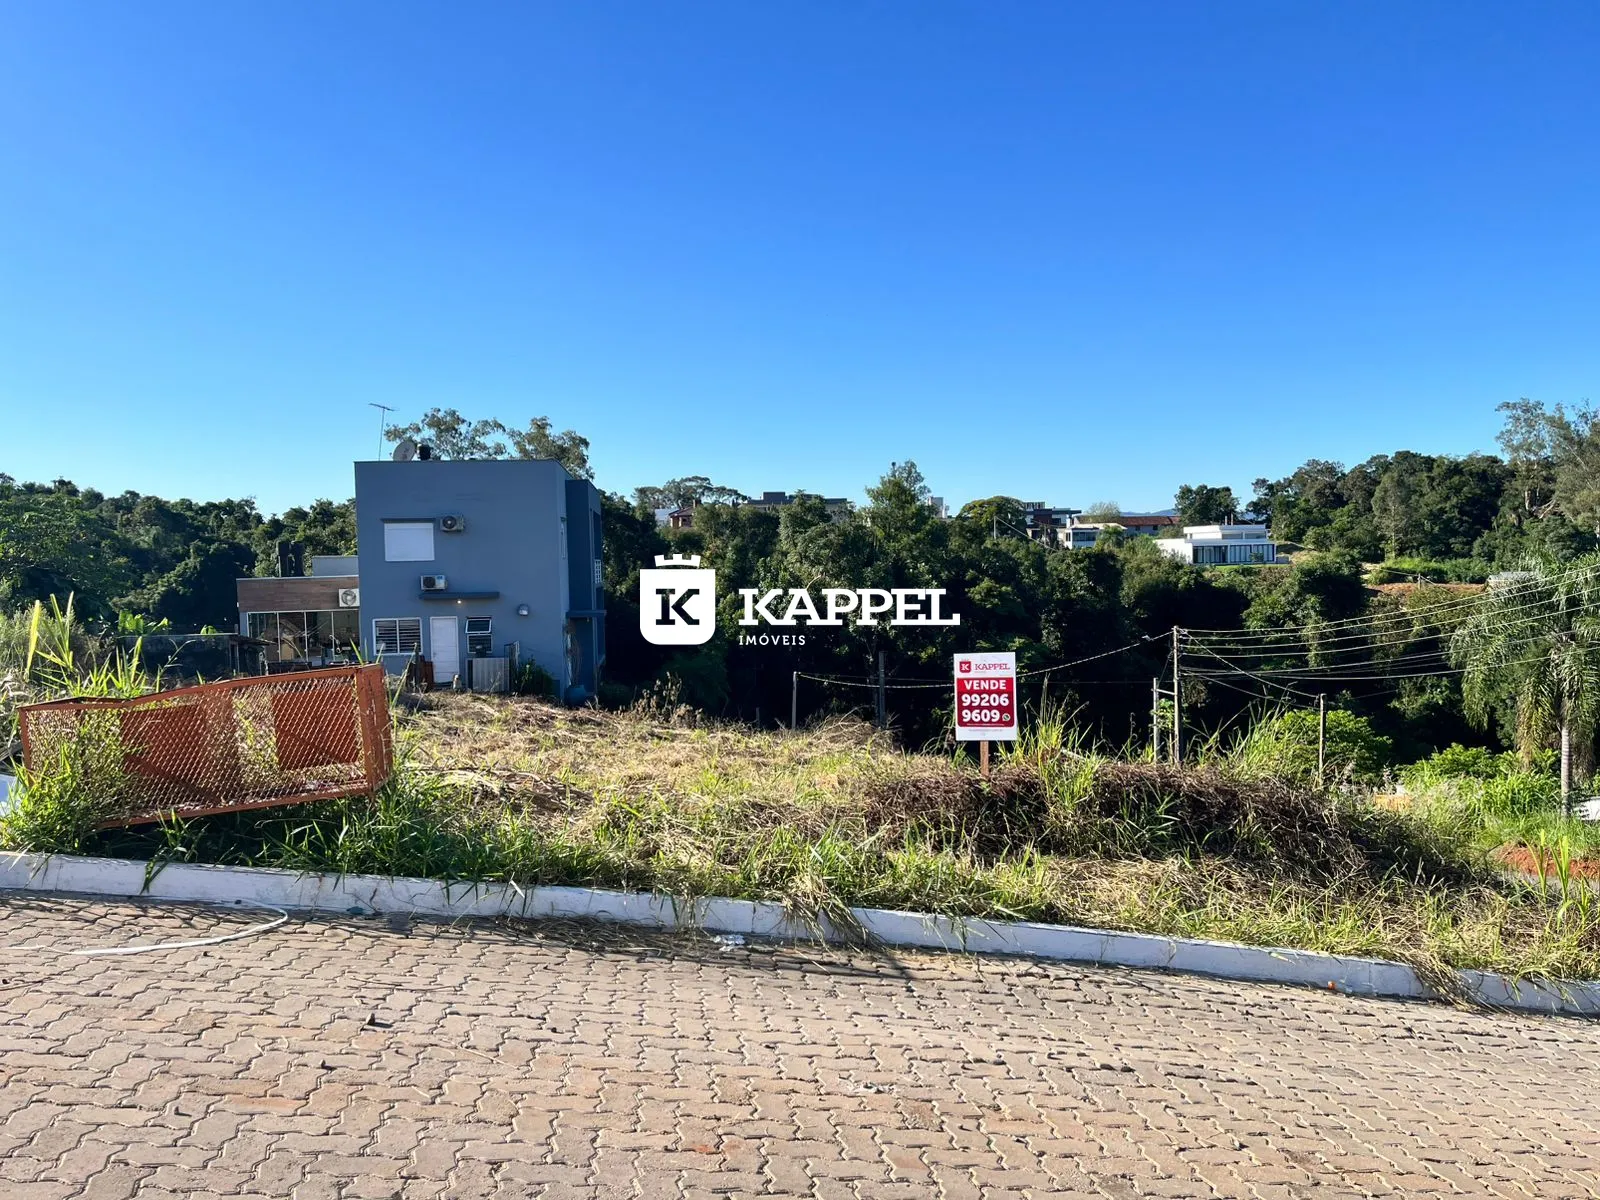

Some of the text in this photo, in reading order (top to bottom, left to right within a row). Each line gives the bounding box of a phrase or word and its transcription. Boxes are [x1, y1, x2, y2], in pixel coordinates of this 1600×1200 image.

[963, 680, 1007, 690] VENDE
[961, 693, 1009, 706] 99206
[961, 709, 1001, 722] 9609
